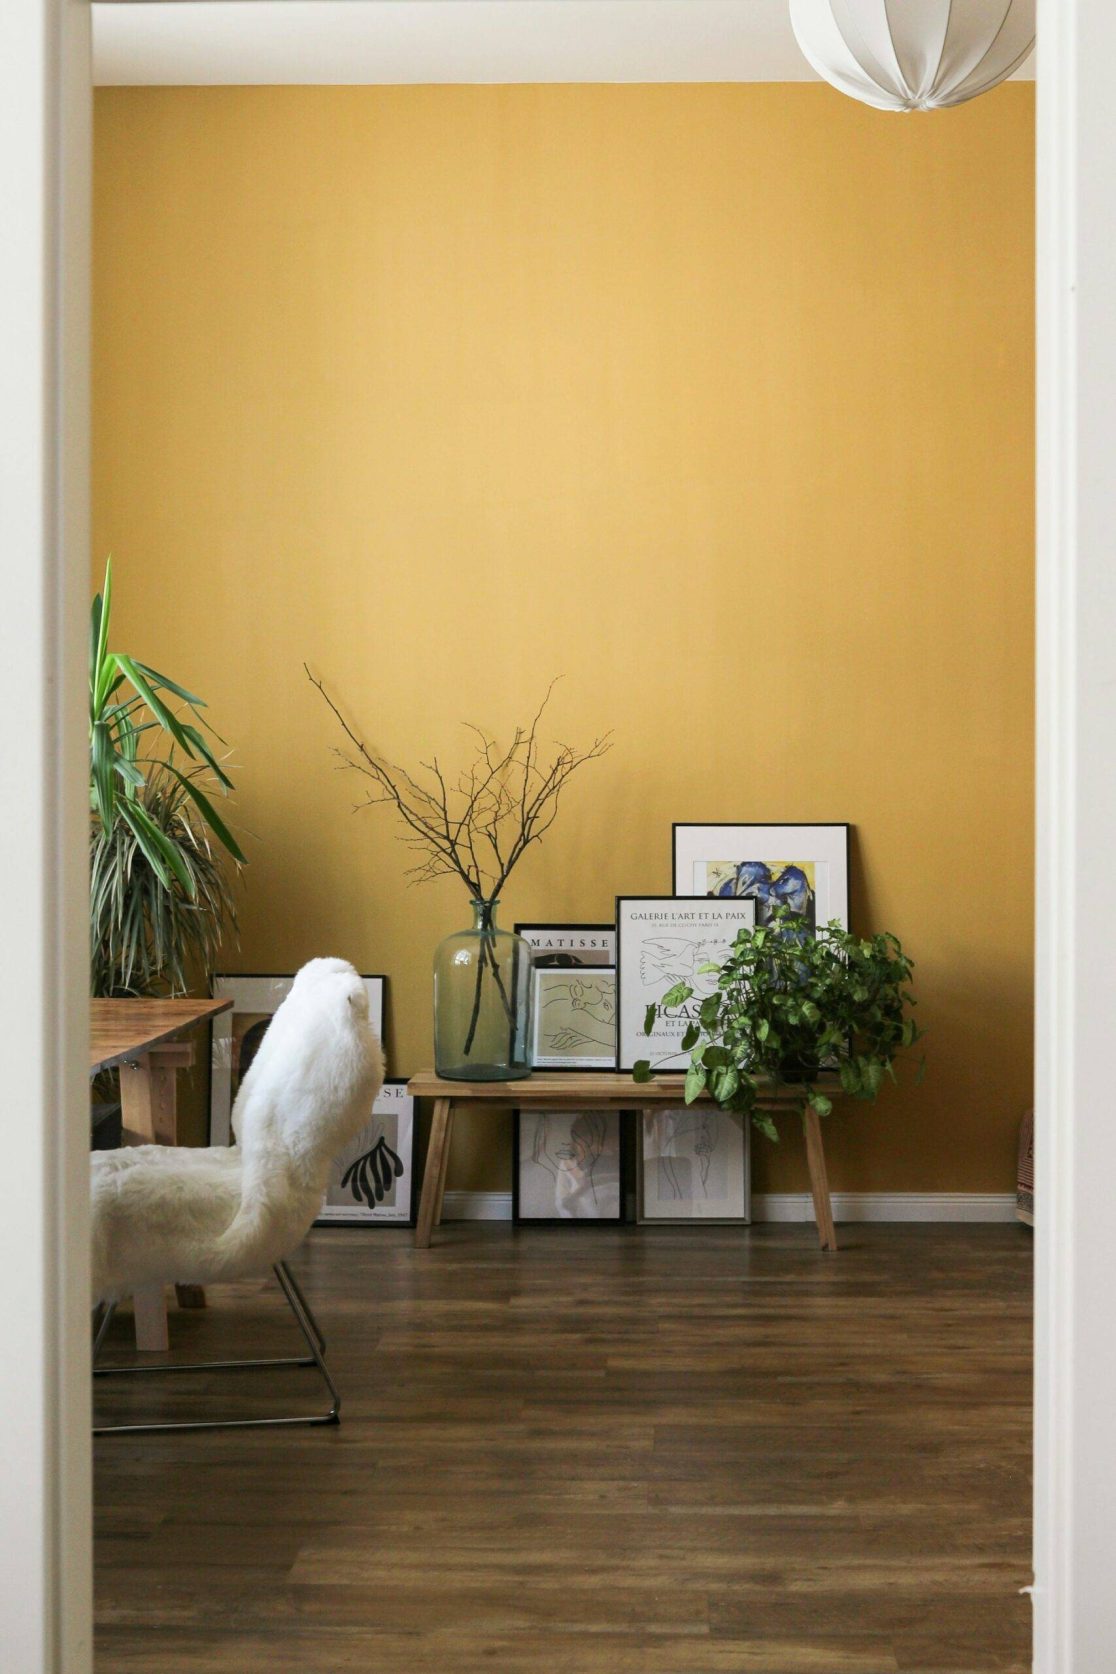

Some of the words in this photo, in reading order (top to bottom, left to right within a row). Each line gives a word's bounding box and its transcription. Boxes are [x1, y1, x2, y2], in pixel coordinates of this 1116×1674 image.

[630, 912, 668, 920] GALERIE
[671, 912, 696, 920] L'ART
[698, 912, 709, 920] ET
[712, 912, 723, 920] LA
[725, 912, 746, 920] PAIX
[531, 939, 608, 947] MATISSE
[644, 1004, 702, 1019] ICAS
